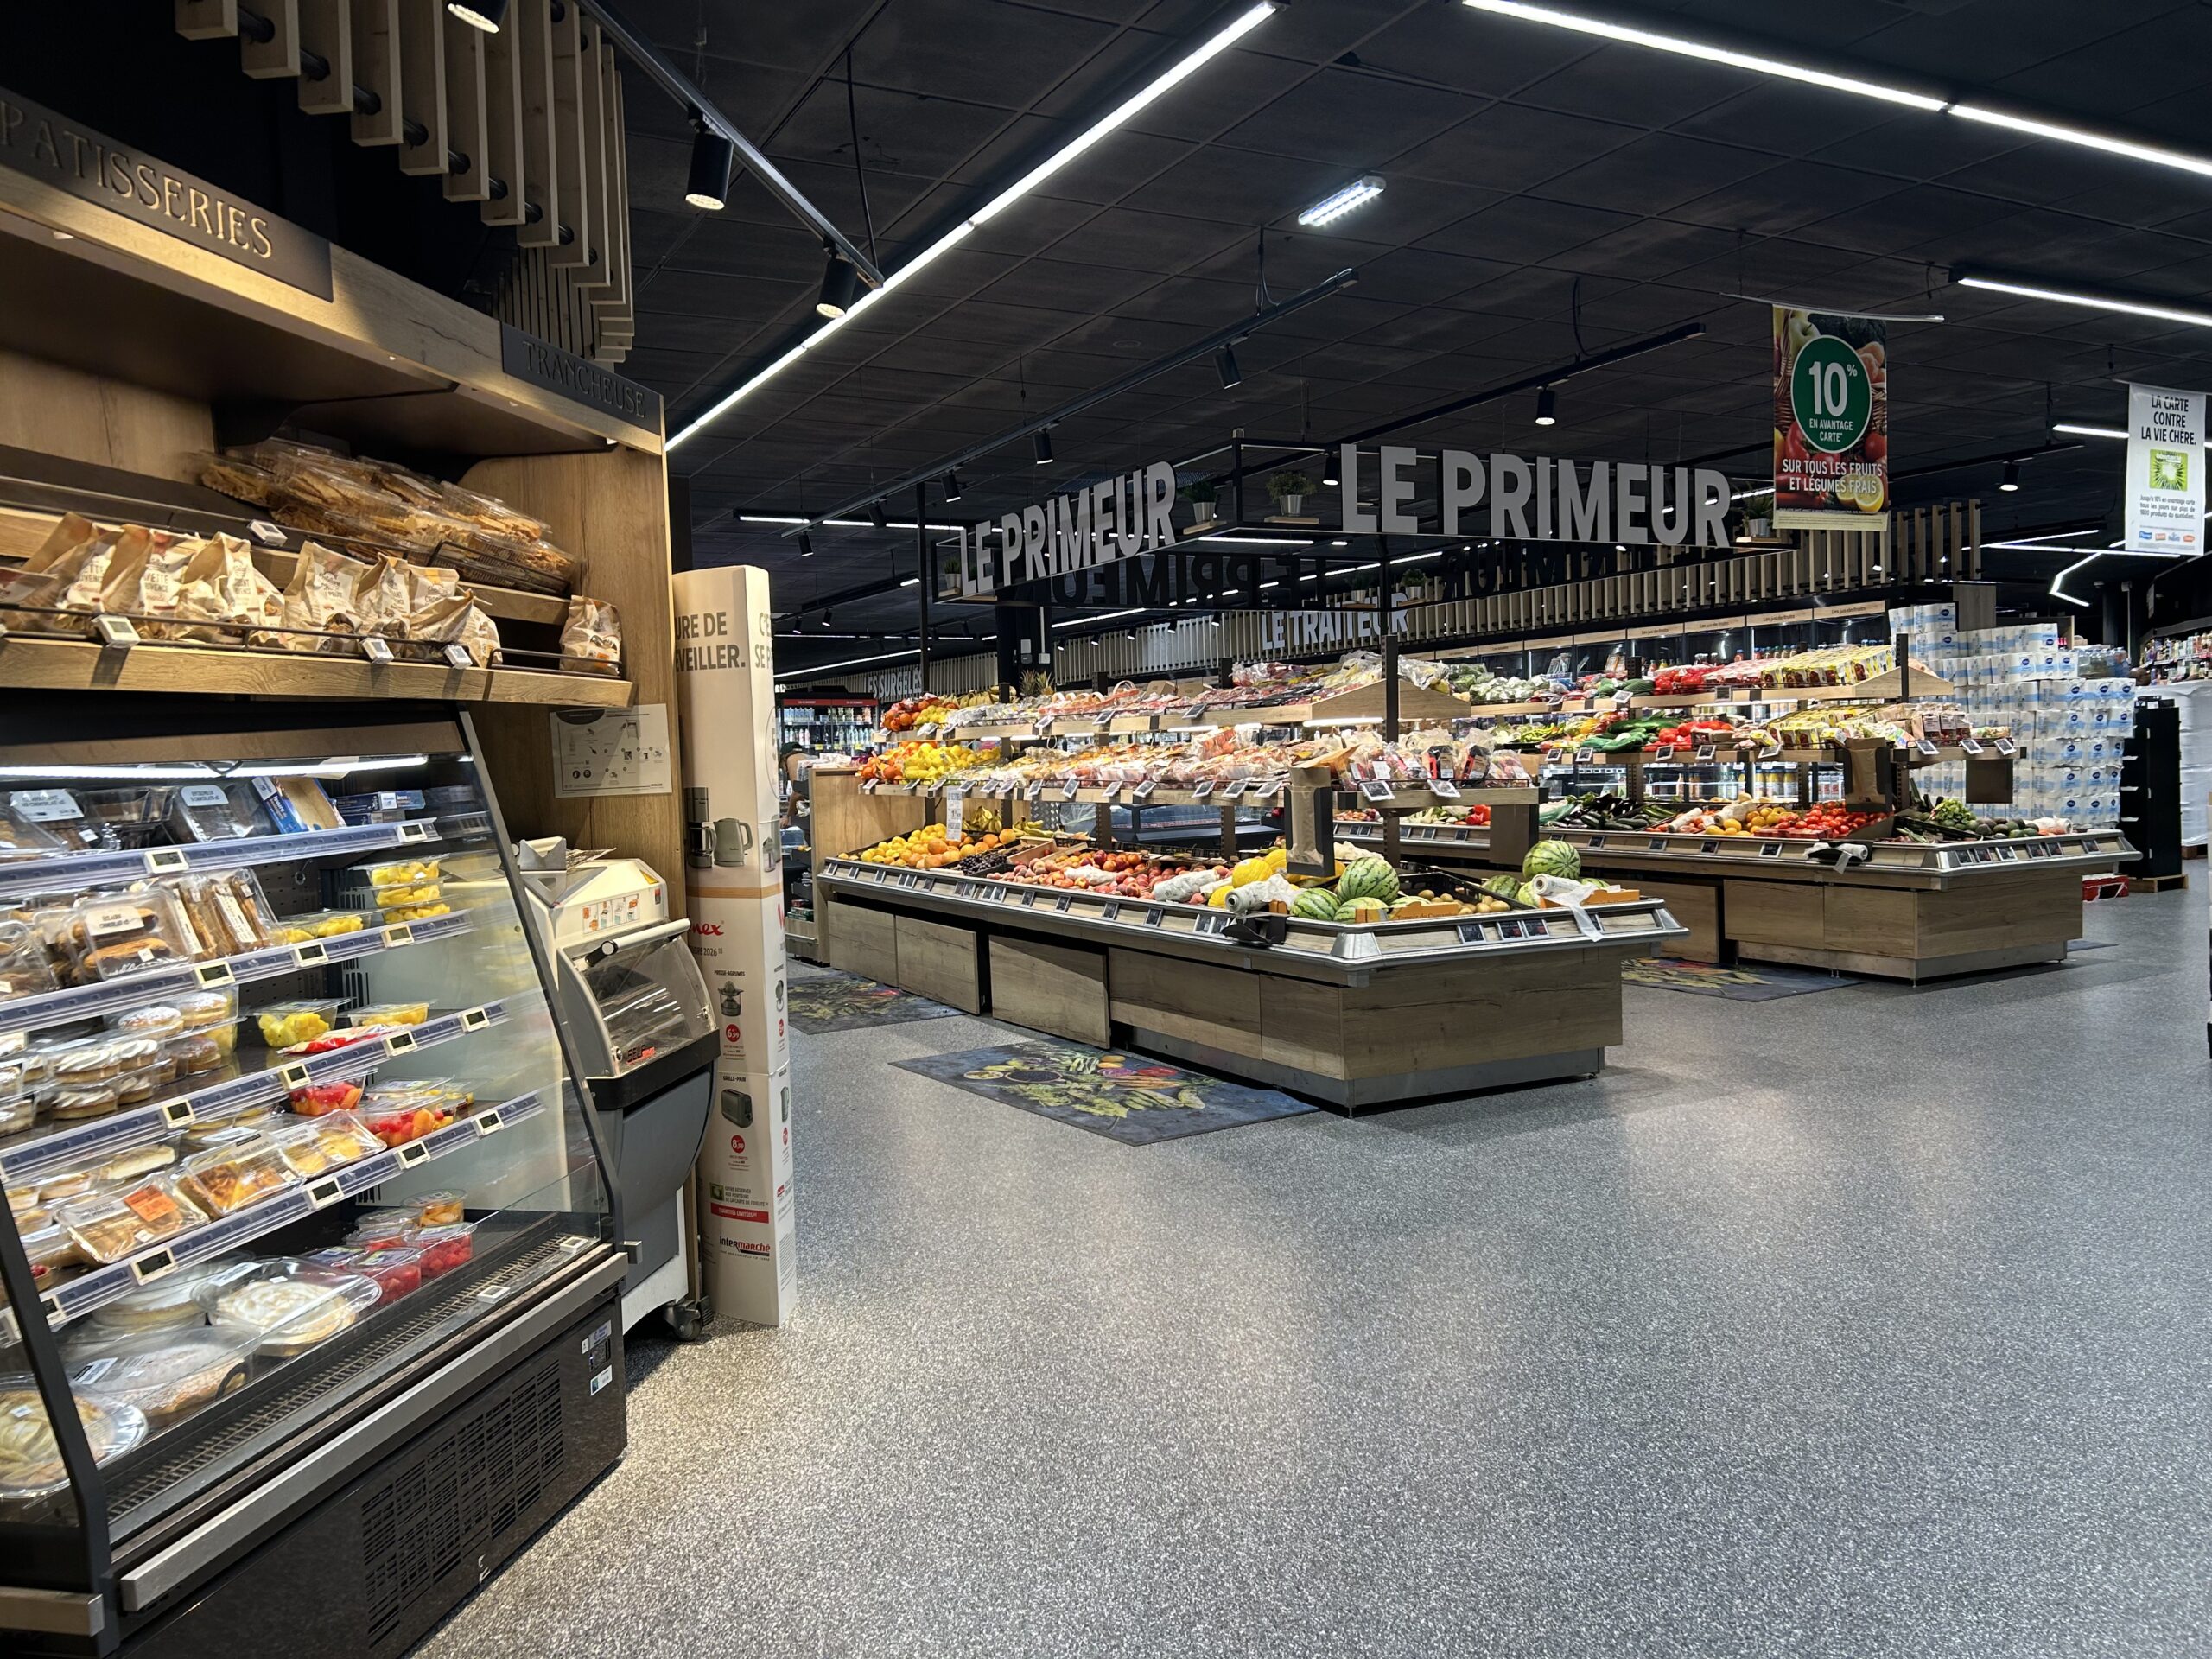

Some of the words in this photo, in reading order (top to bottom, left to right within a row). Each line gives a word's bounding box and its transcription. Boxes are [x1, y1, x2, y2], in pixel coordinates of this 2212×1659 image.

[0, 101, 271, 258] PATISSERIES
[522, 340, 645, 418] TRANCHEUSE
[2152, 394, 2161, 409] LA
[2164, 397, 2189, 412] CARTE
[1809, 419, 1818, 429] EN
[1820, 420, 1853, 430] AVANTAGE
[2153, 411, 2186, 428] CONTRE
[2141, 426, 2151, 441] LA
[2153, 427, 2166, 442] VIE
[2169, 428, 2196, 445] CHÈRE.
[1783, 459, 1802, 473] SUR
[1804, 460, 1827, 474] TOUS
[1830, 461, 1847, 475] LES
[1849, 462, 1883, 476] FRUITS
[1789, 477, 1802, 491] ET
[1804, 474, 1847, 493] LÉGUMES
[1848, 480, 1877, 493] FRAIS
[1341, 443, 1418, 533] LE
[1442, 449, 1731, 548] PRIMEUR
[960, 520, 994, 596] LE
[1001, 461, 1176, 587] PRIMEUR
[703, 612, 728, 637] DE
[1262, 611, 1285, 651] LE
[1289, 592, 1408, 646] TRAITEUR
[755, 644, 766, 668] SE
[879, 664, 923, 698] SURGELÉS
[704, 947, 718, 957] 2026
[720, 1236, 770, 1253] Intermarché
